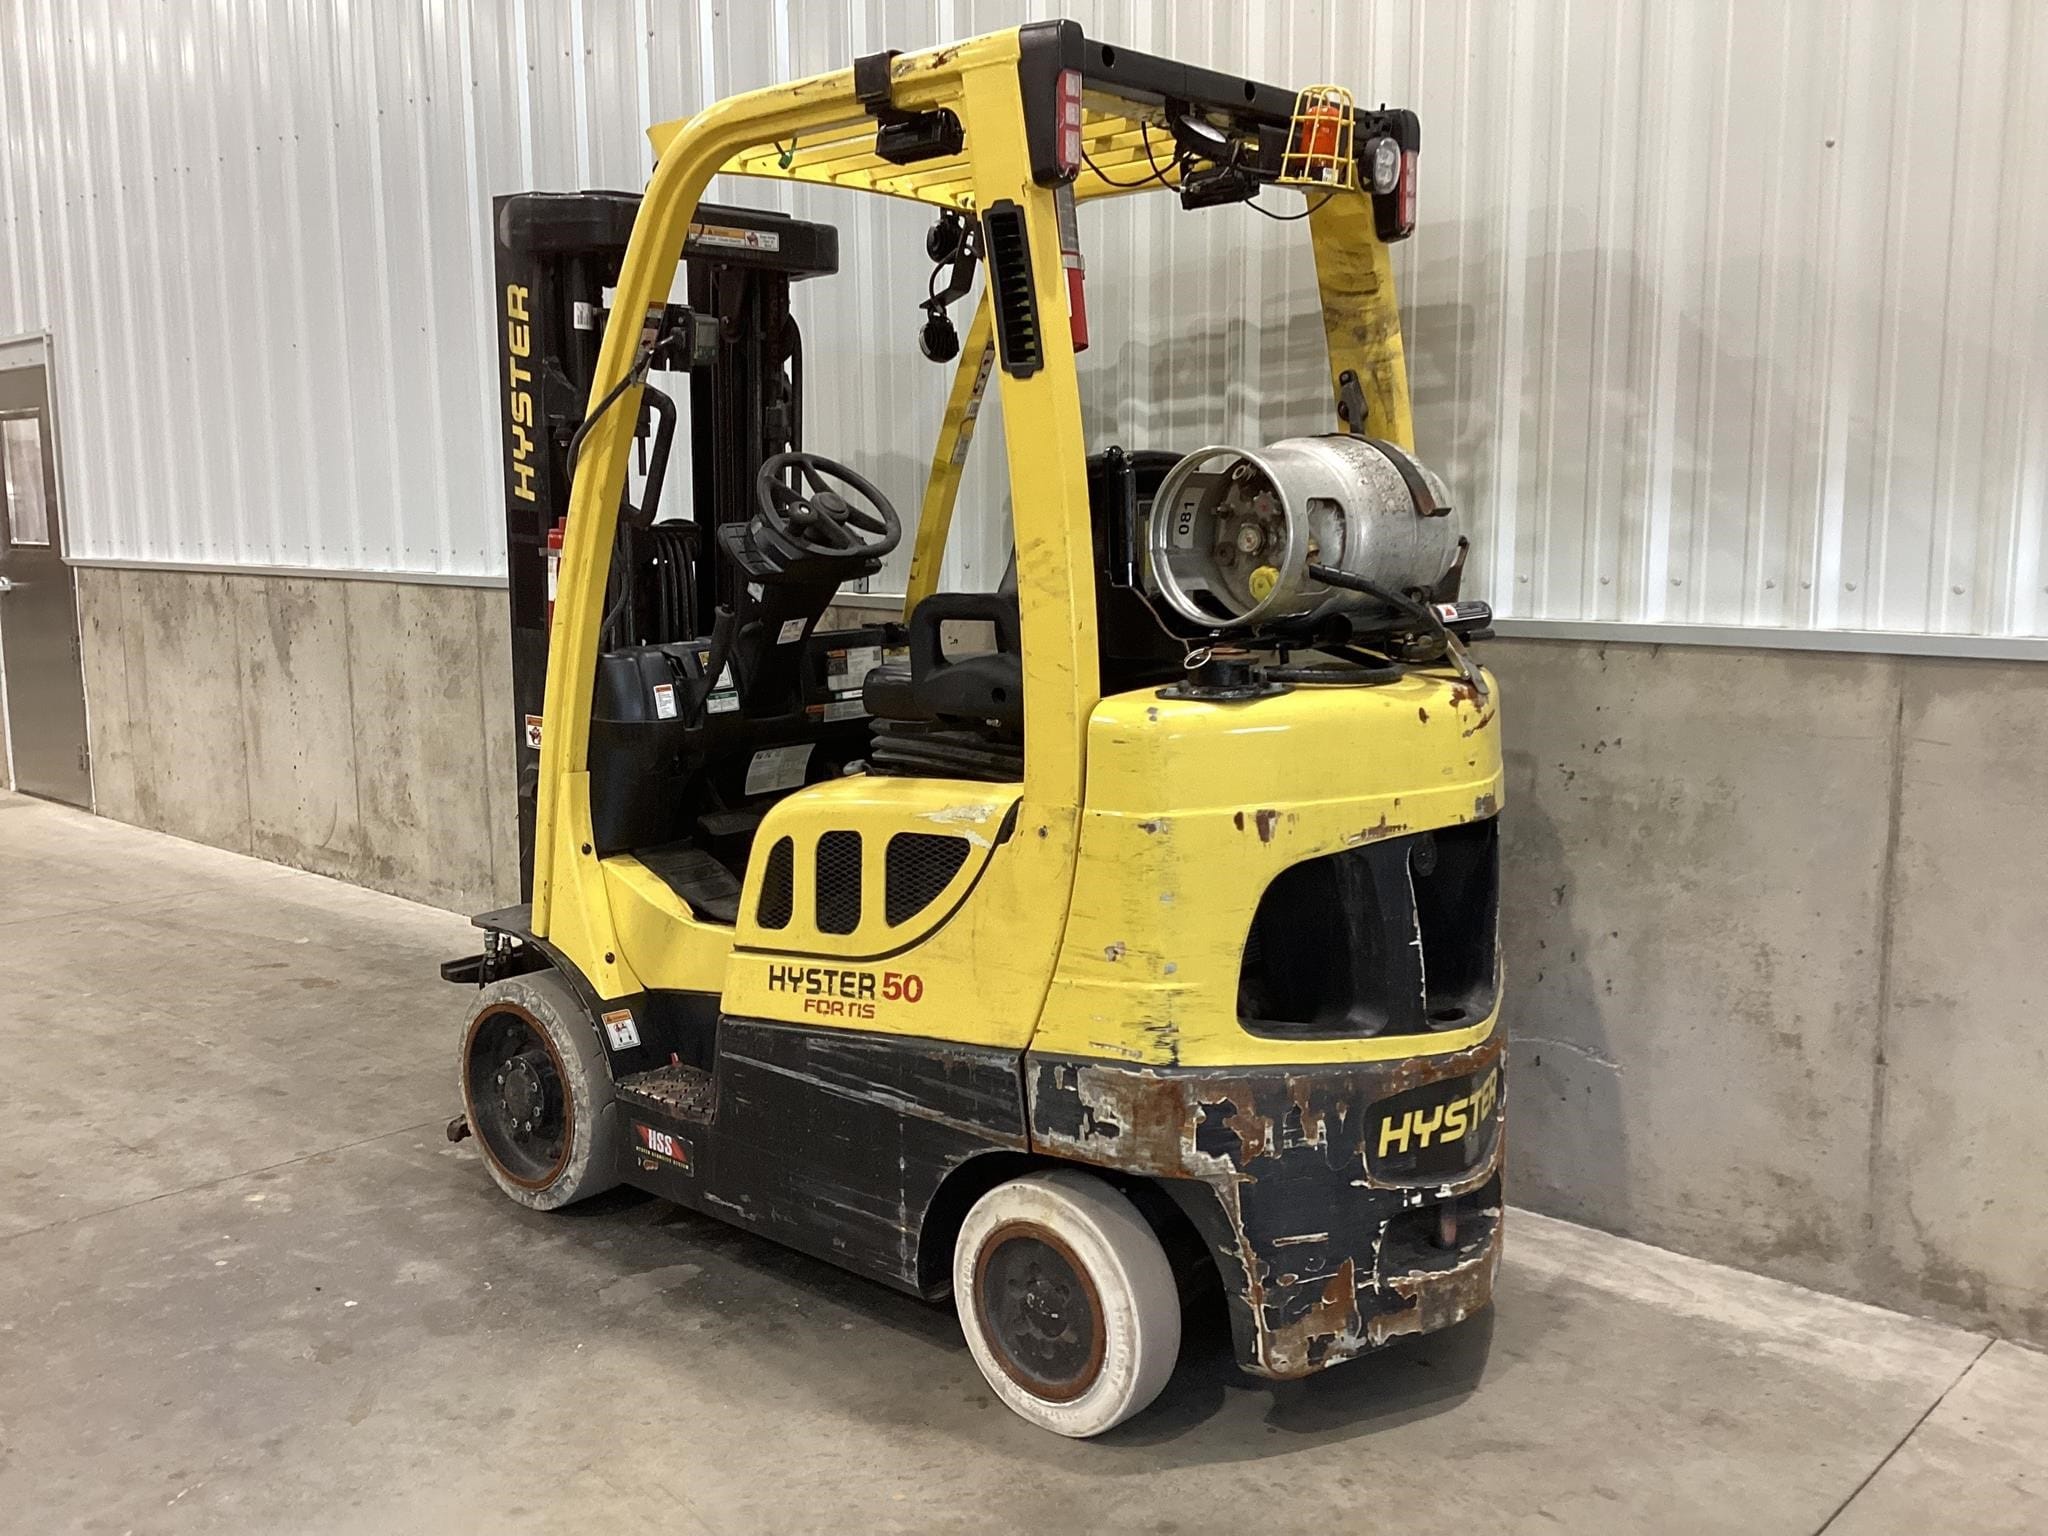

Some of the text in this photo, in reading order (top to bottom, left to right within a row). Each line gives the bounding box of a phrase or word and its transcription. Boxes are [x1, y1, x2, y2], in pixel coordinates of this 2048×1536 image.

[507, 284, 535, 502] HYSTER
[1179, 502, 1195, 535] 081
[769, 965, 924, 1003] HYSTER 50
[1378, 1067, 1498, 1158] HYSTER
[648, 1128, 673, 1156] HSS
